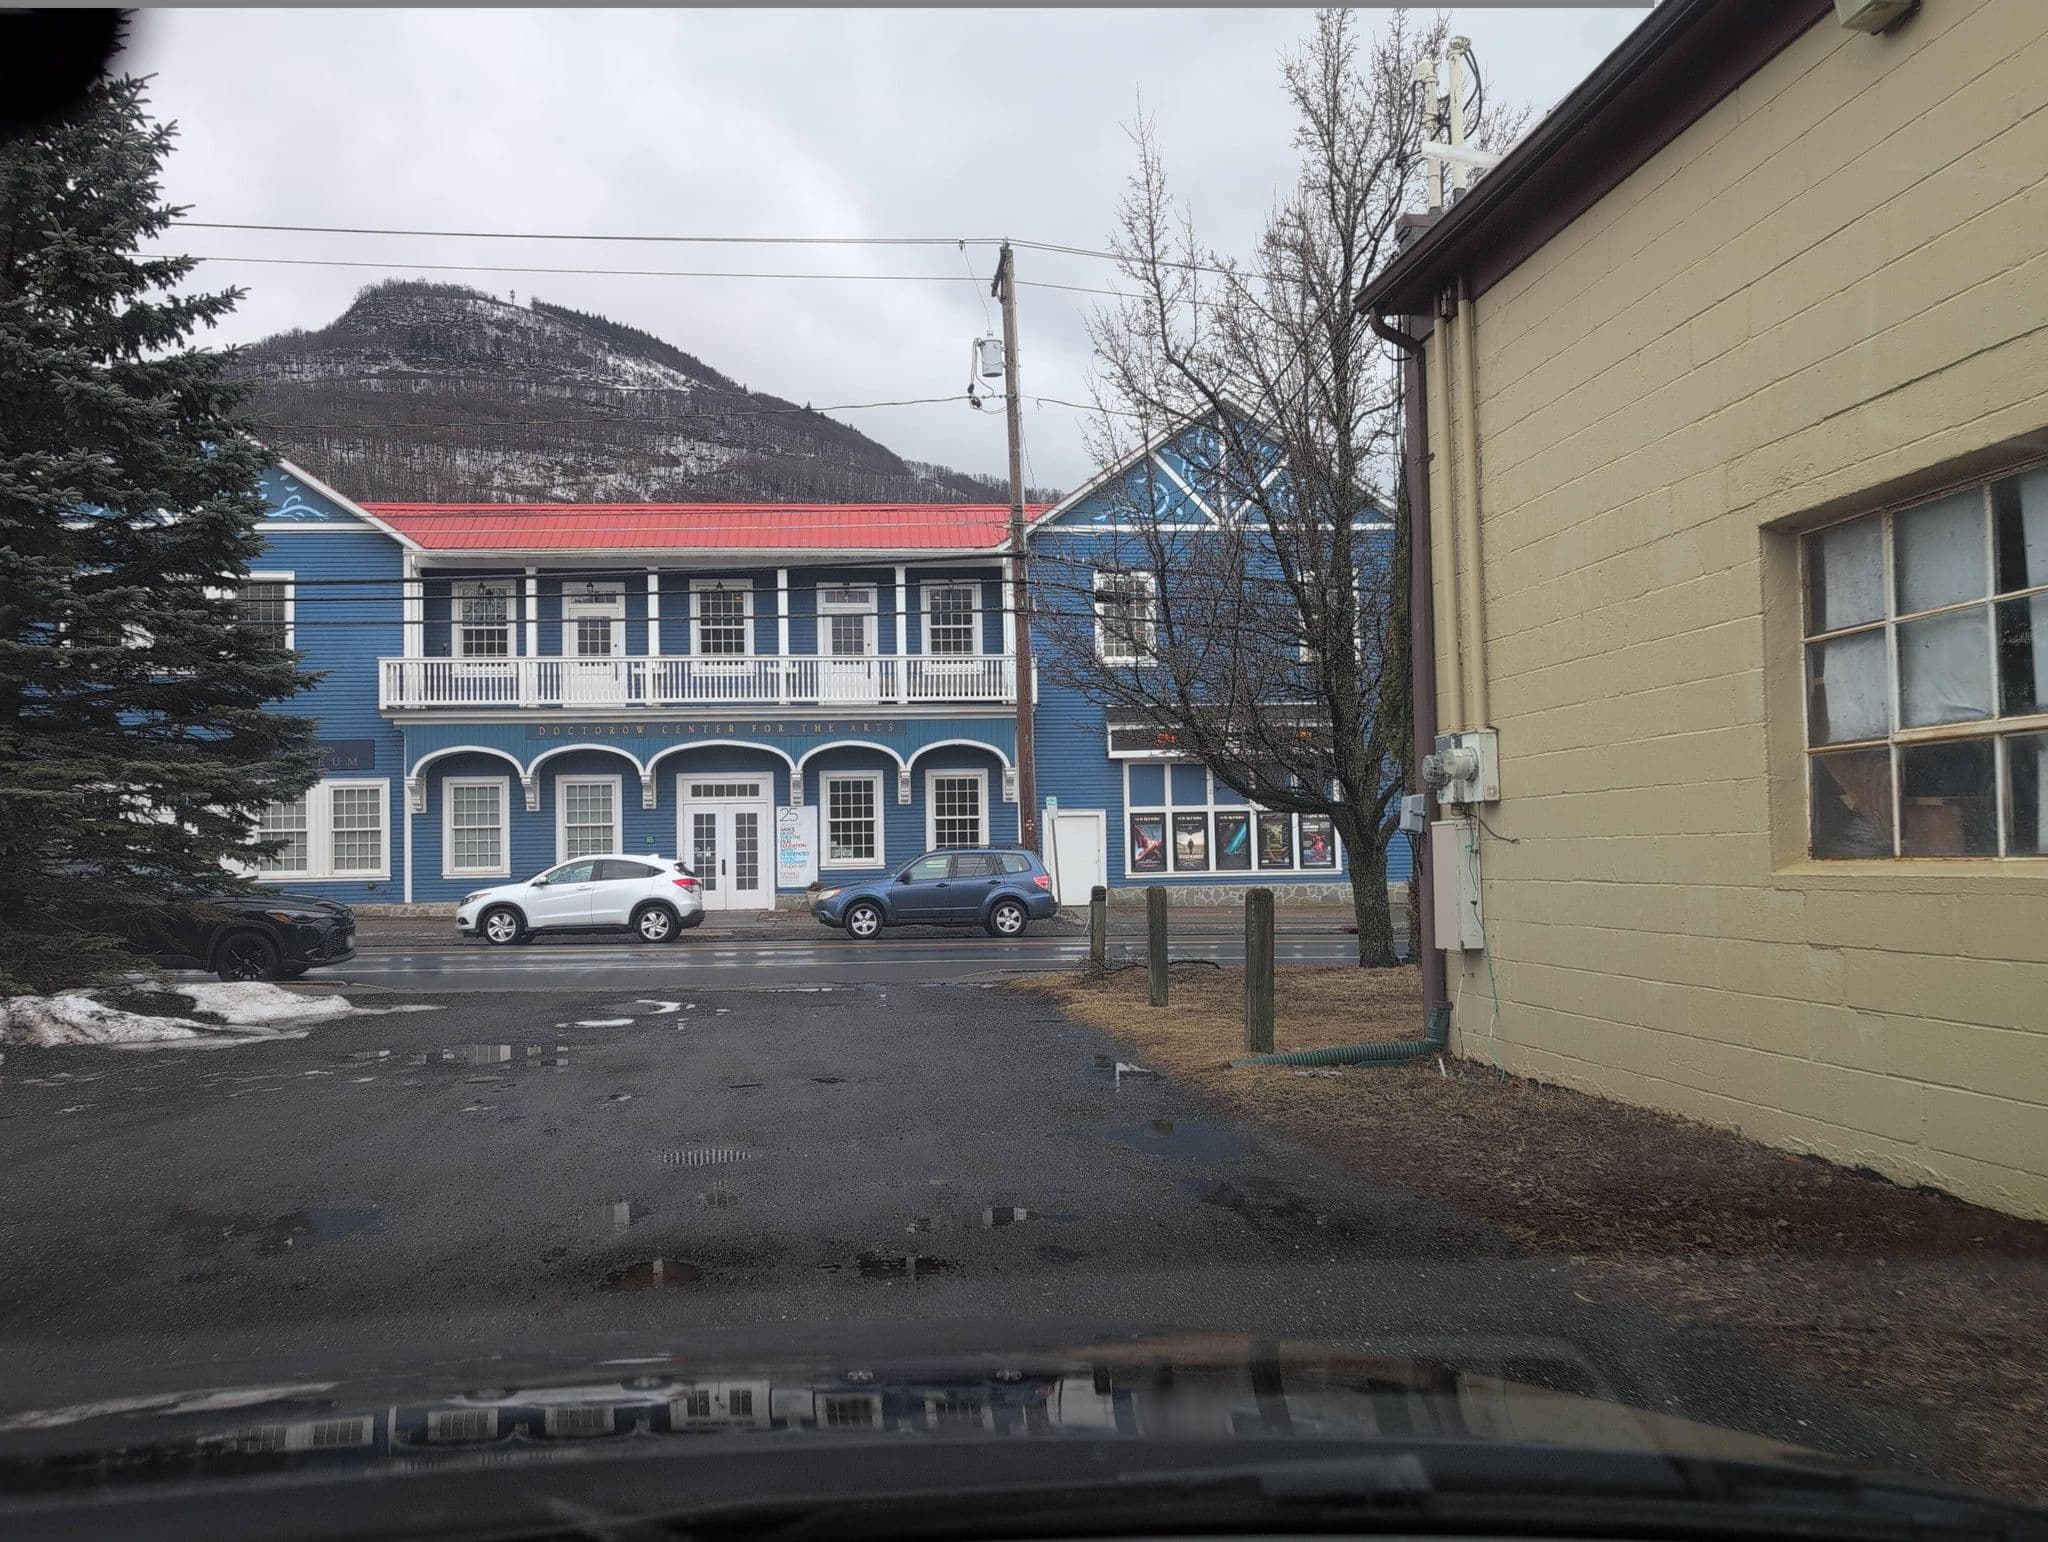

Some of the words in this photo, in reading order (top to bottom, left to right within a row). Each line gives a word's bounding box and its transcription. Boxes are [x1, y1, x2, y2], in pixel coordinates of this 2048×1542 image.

[538, 725, 646, 736] DOCTOROW
[661, 724, 736, 735] CENTER
[751, 723, 785, 733] FOR
[800, 723, 835, 733] THE
[850, 722, 895, 733] ARTS
[779, 807, 798, 822] 25
